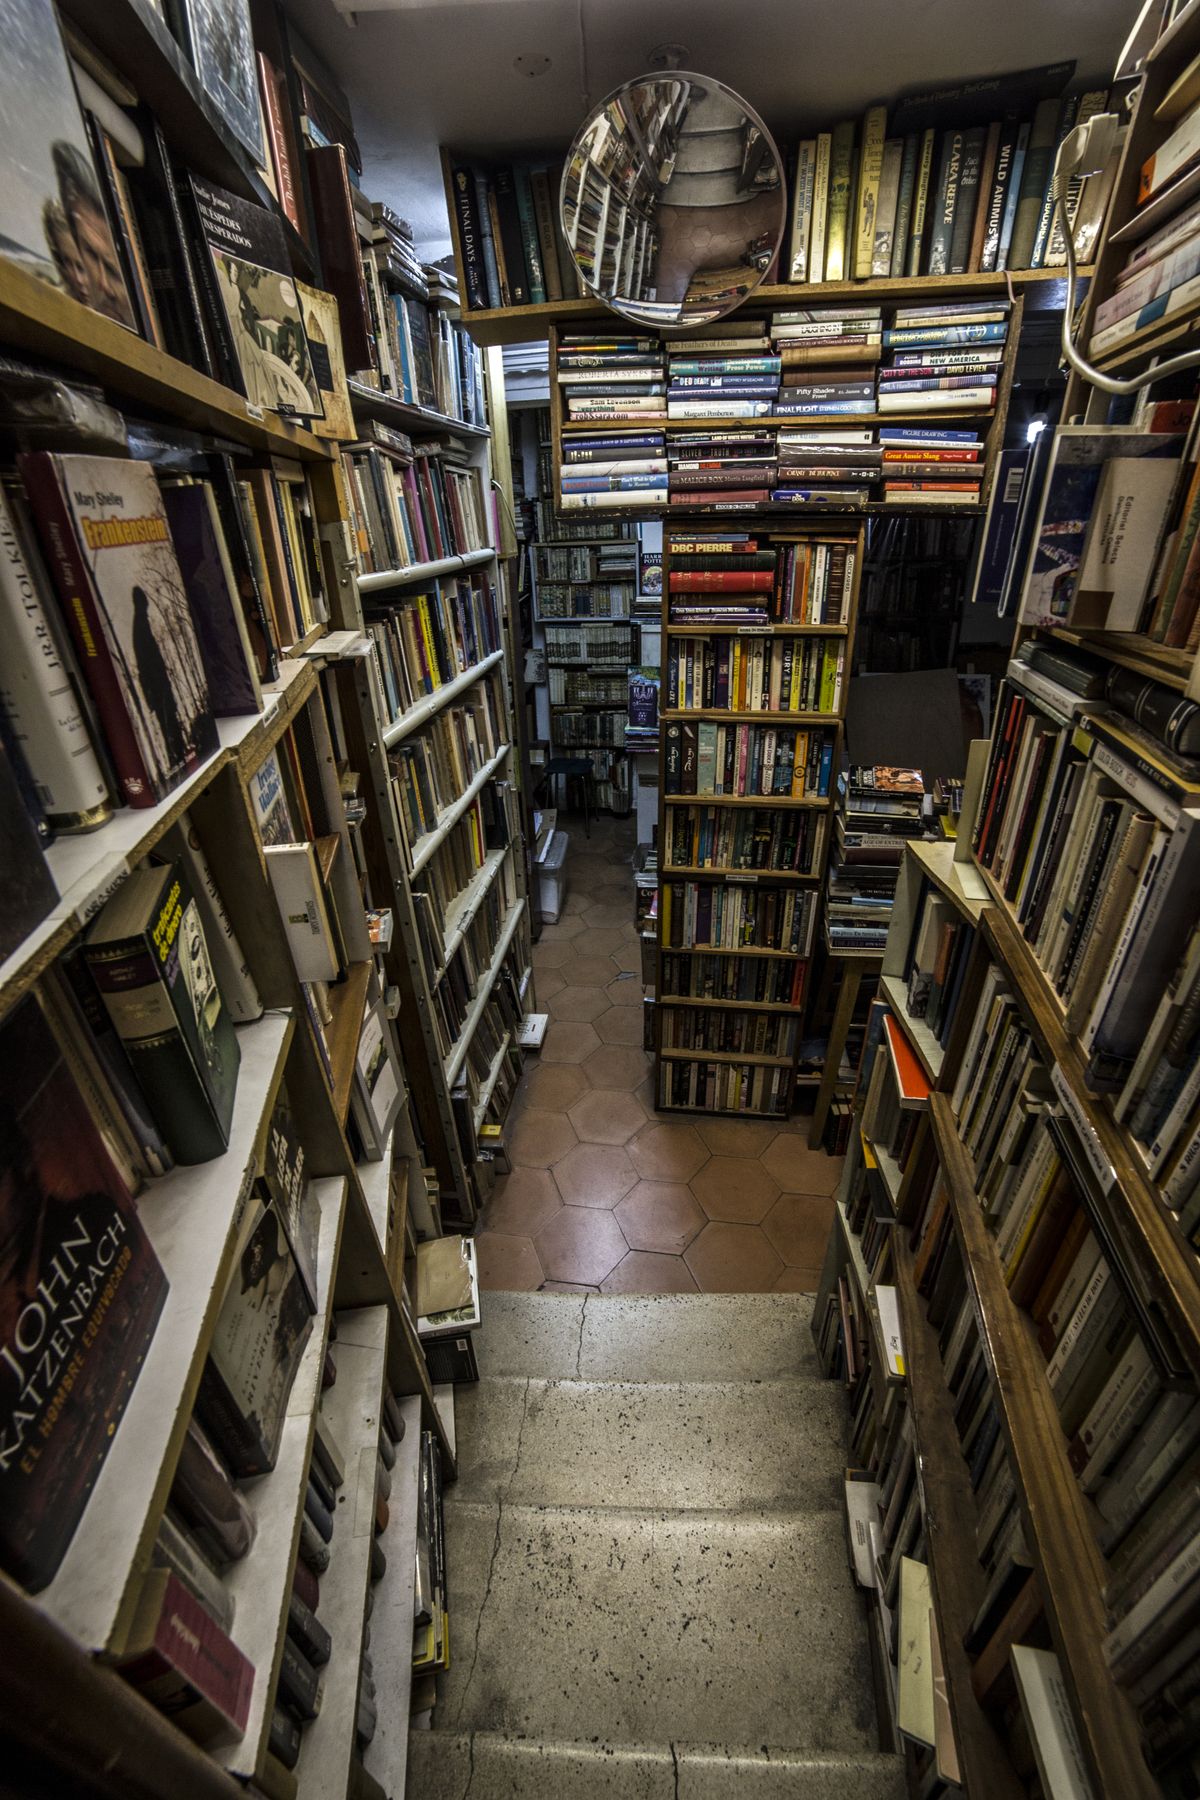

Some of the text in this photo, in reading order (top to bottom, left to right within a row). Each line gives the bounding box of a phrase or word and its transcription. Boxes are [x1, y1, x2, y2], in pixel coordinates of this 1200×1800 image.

[922, 138, 932, 168] Twenty
[918, 170, 929, 200] Singing
[944, 134, 963, 225] CLARA REEVE
[989, 144, 1011, 235] WILD ANIMUS
[460, 199, 476, 262] FINAL DAYS
[578, 370, 620, 379] ROBERTA
[923, 452, 940, 461] Slang
[73, 488, 125, 508] Mary Shelley
[82, 516, 170, 550] Frankenstein
[671, 543, 733, 552] DBC PIERRE
[1109, 495, 1134, 566] Editorial Selecta
[48, 521, 97, 657] Frankenstein Mary Shelley
[34, 626, 60, 669] J.R.R.
[256, 756, 277, 788] Irving
[284, 1160, 292, 1195] DE
[0, 1214, 92, 1383] JOHN
[0, 1212, 126, 1470] KATZENBACH
[20, 1246, 132, 1474] EL HOMBRE EQUIVOCADO
